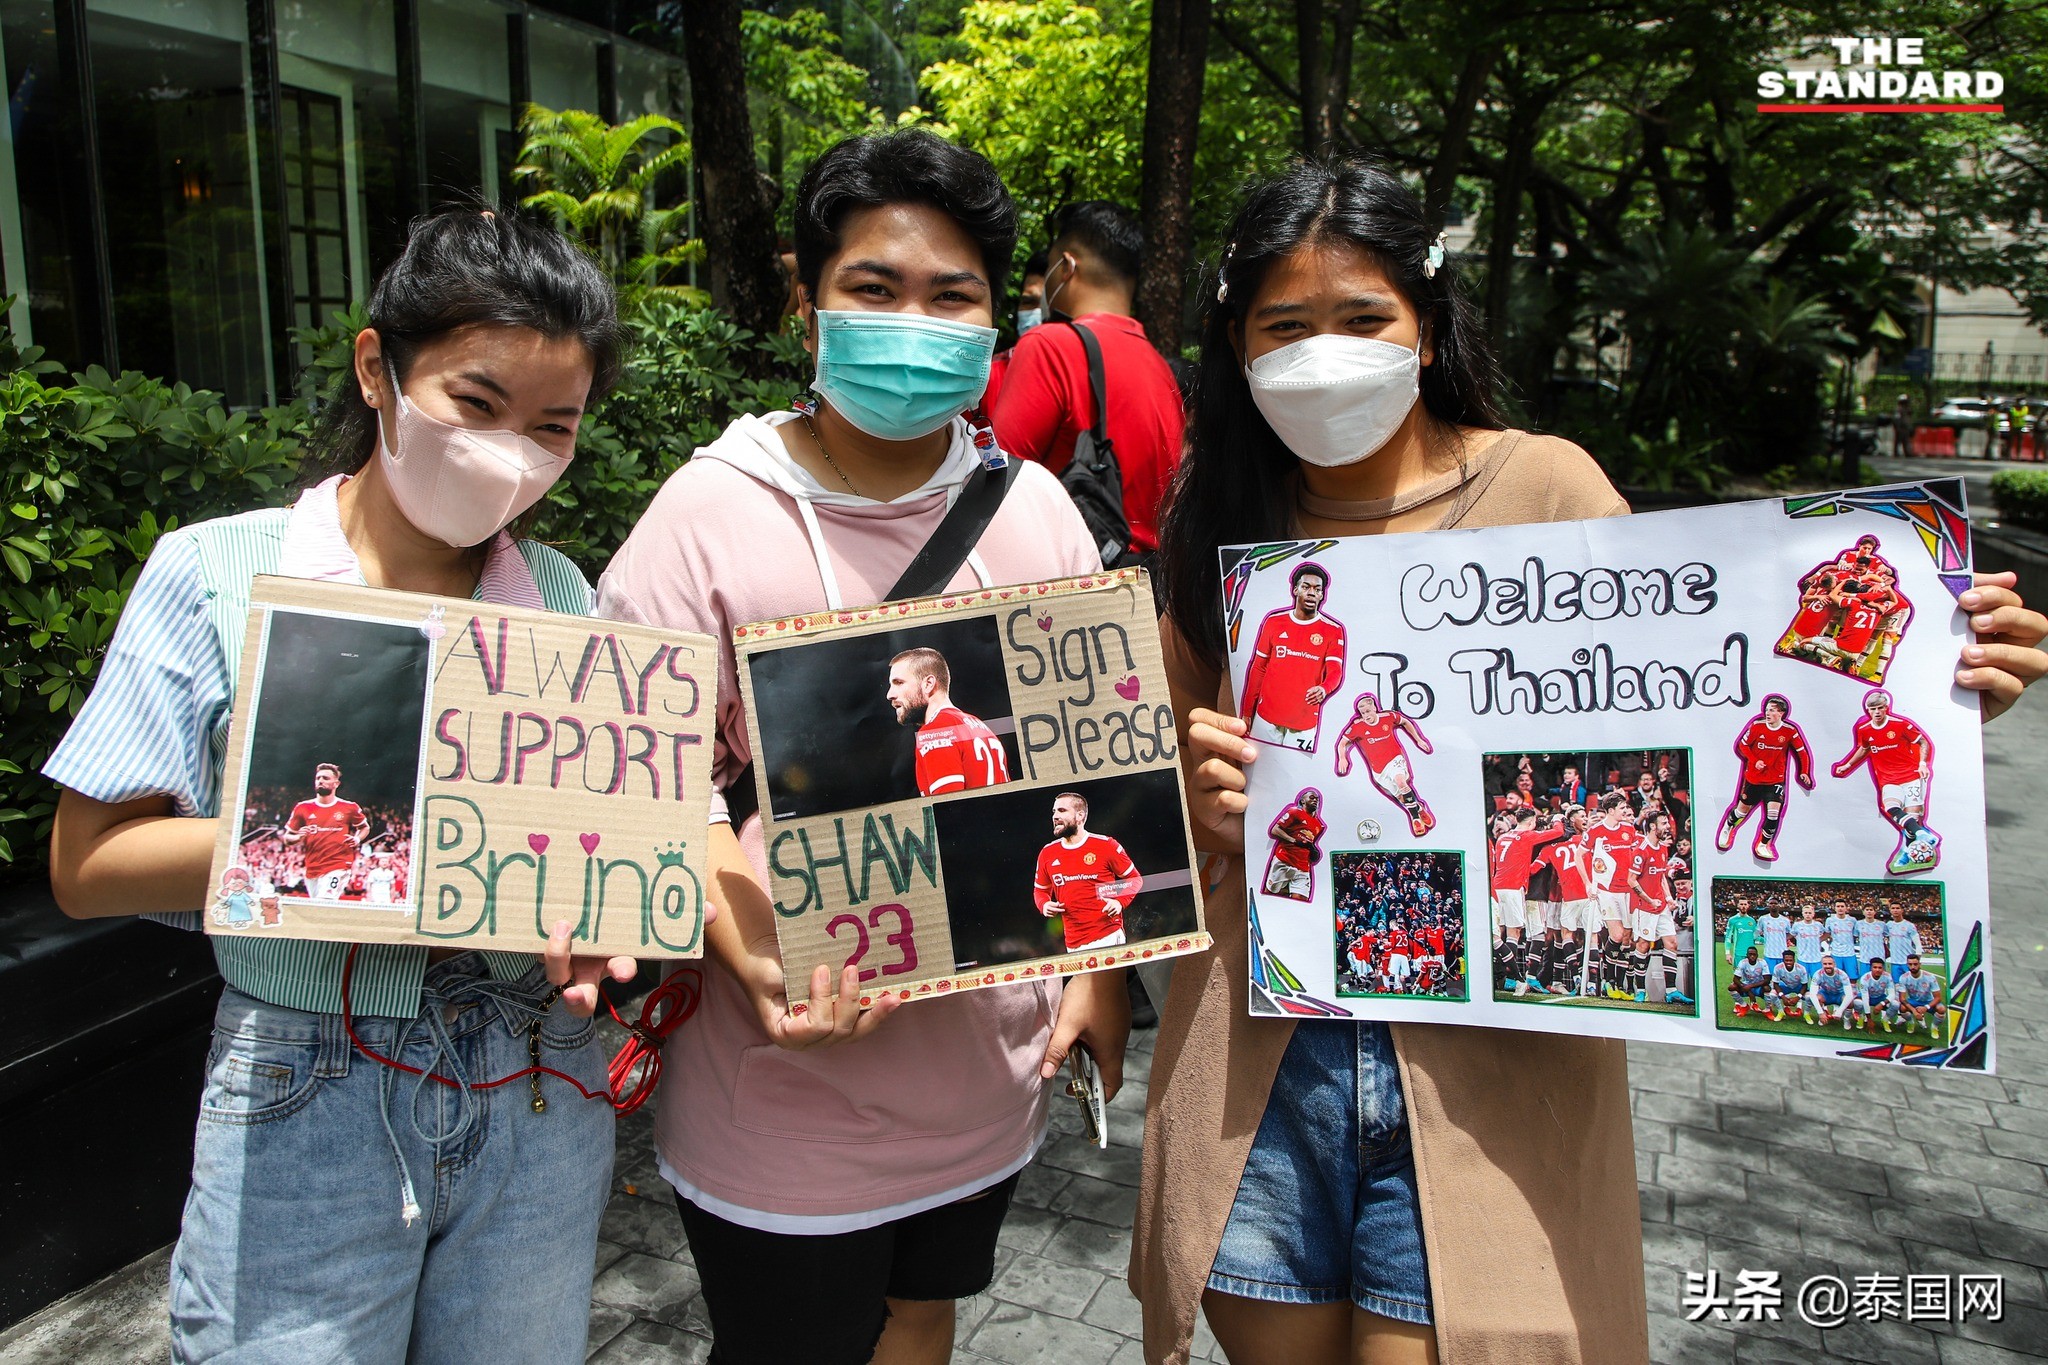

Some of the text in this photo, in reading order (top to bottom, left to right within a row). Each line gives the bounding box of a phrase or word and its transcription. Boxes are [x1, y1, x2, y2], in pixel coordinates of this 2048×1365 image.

[1399, 555, 1718, 631] Welcome
[433, 616, 702, 718] ALWAYS
[1005, 605, 1137, 707] Sign
[1360, 631, 1749, 720] To Thailand
[431, 707, 702, 802] SUPPORT
[1020, 700, 1178, 781] Please
[1907, 785, 1921, 798] 33
[330, 876, 339, 889] 8
[415, 795, 704, 953] Bruno
[769, 806, 938, 918] SHAW
[824, 902, 919, 982] 23
